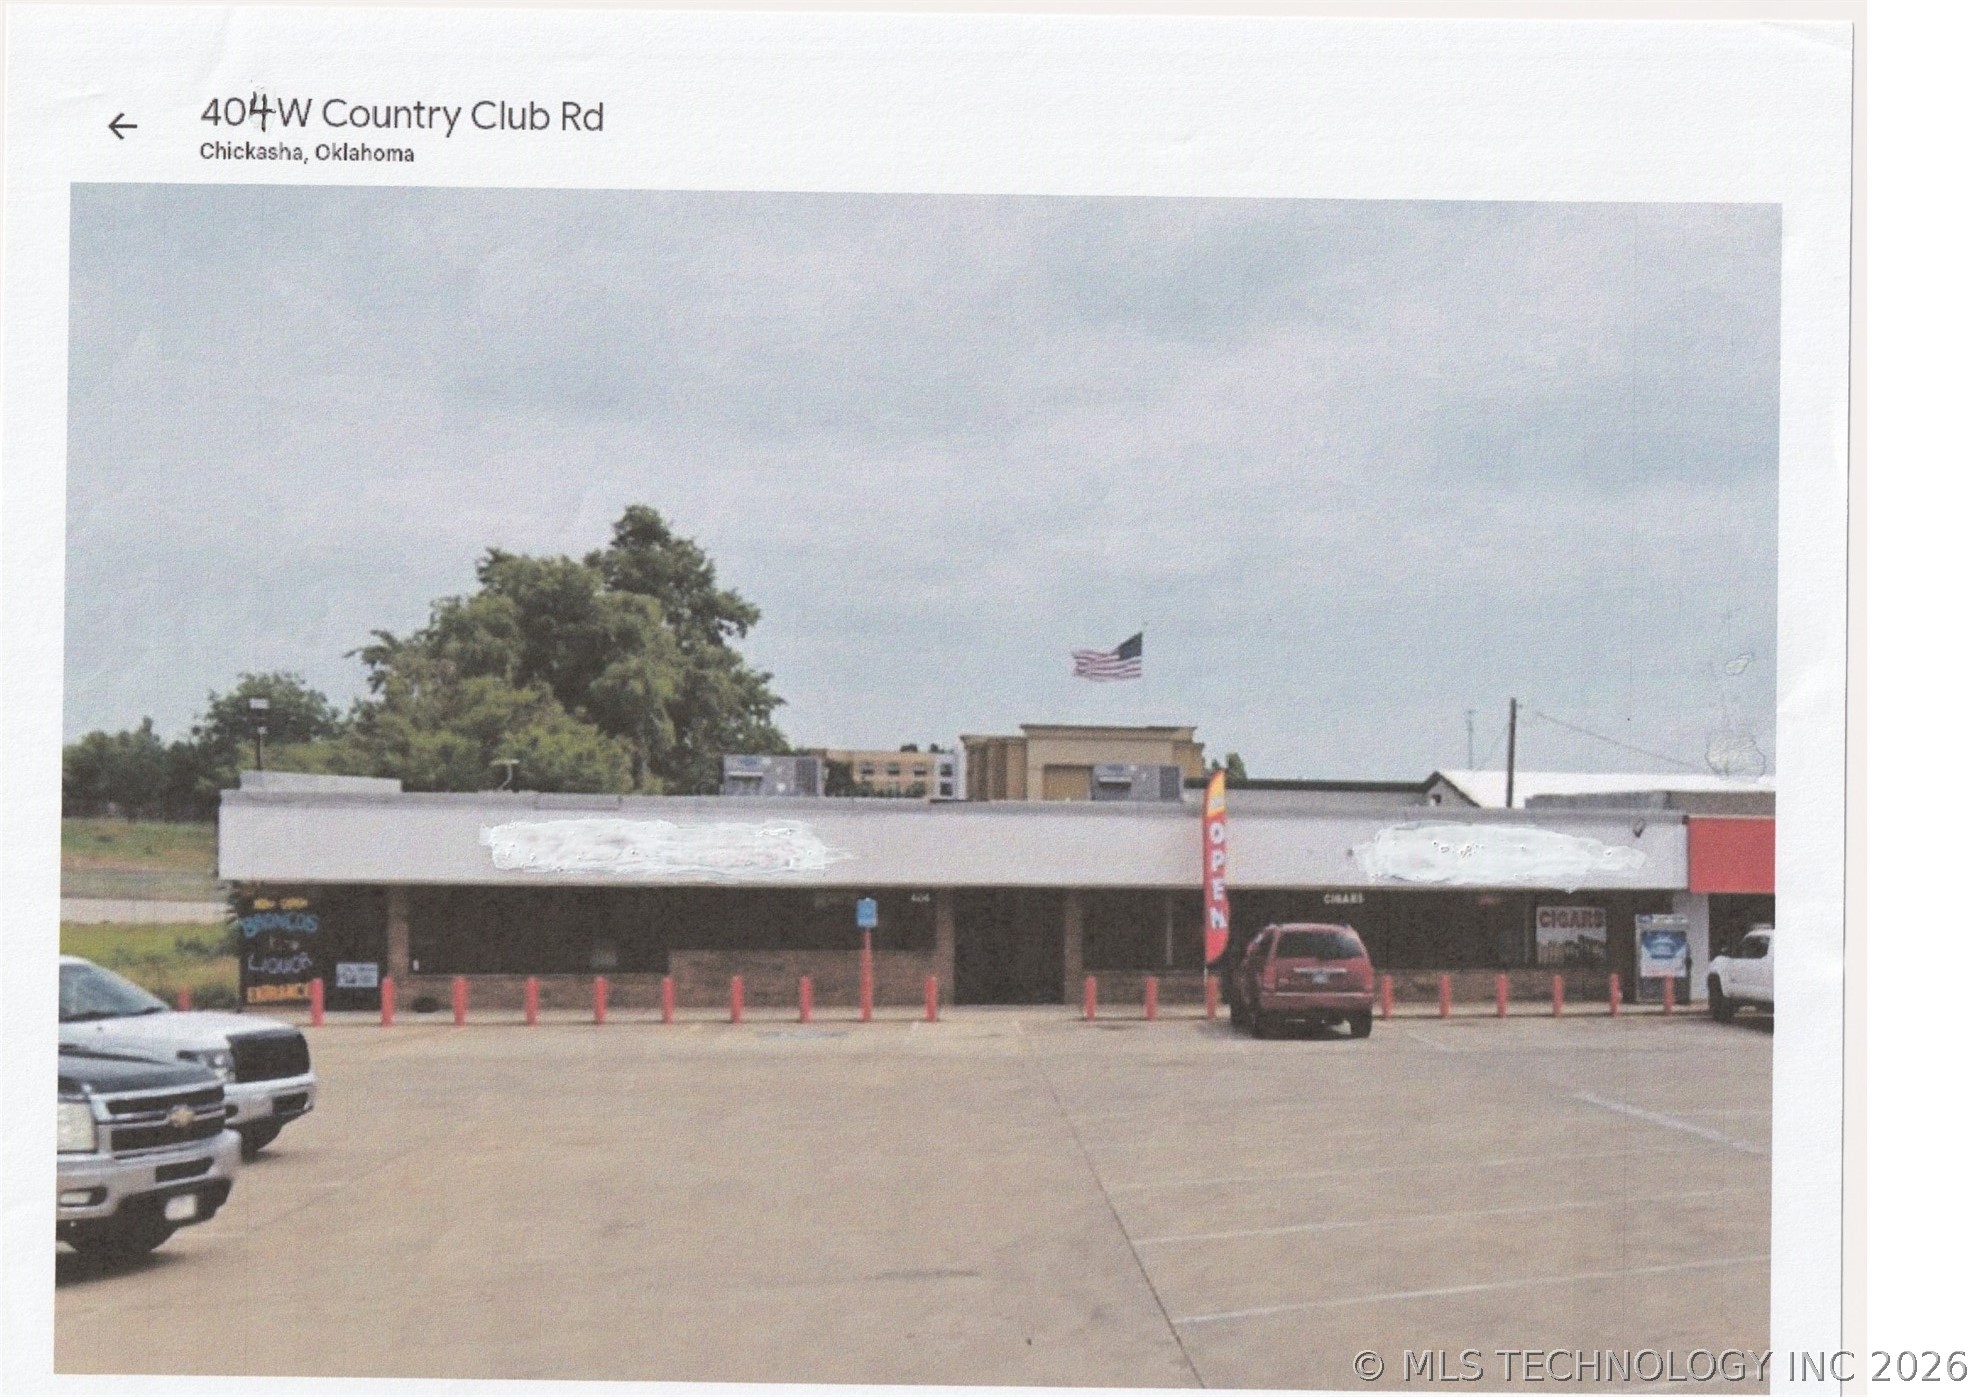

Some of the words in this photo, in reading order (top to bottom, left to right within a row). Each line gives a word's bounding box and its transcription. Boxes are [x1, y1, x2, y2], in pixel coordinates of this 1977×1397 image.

[322, 98, 461, 137] Country
[471, 99, 550, 131] Club
[562, 101, 605, 132] Rd
[200, 141, 309, 164] Chickasha,
[315, 143, 415, 163] Oklahoma
[1209, 821, 1227, 930] OPEN
[1539, 911, 1605, 928] CIGARS
